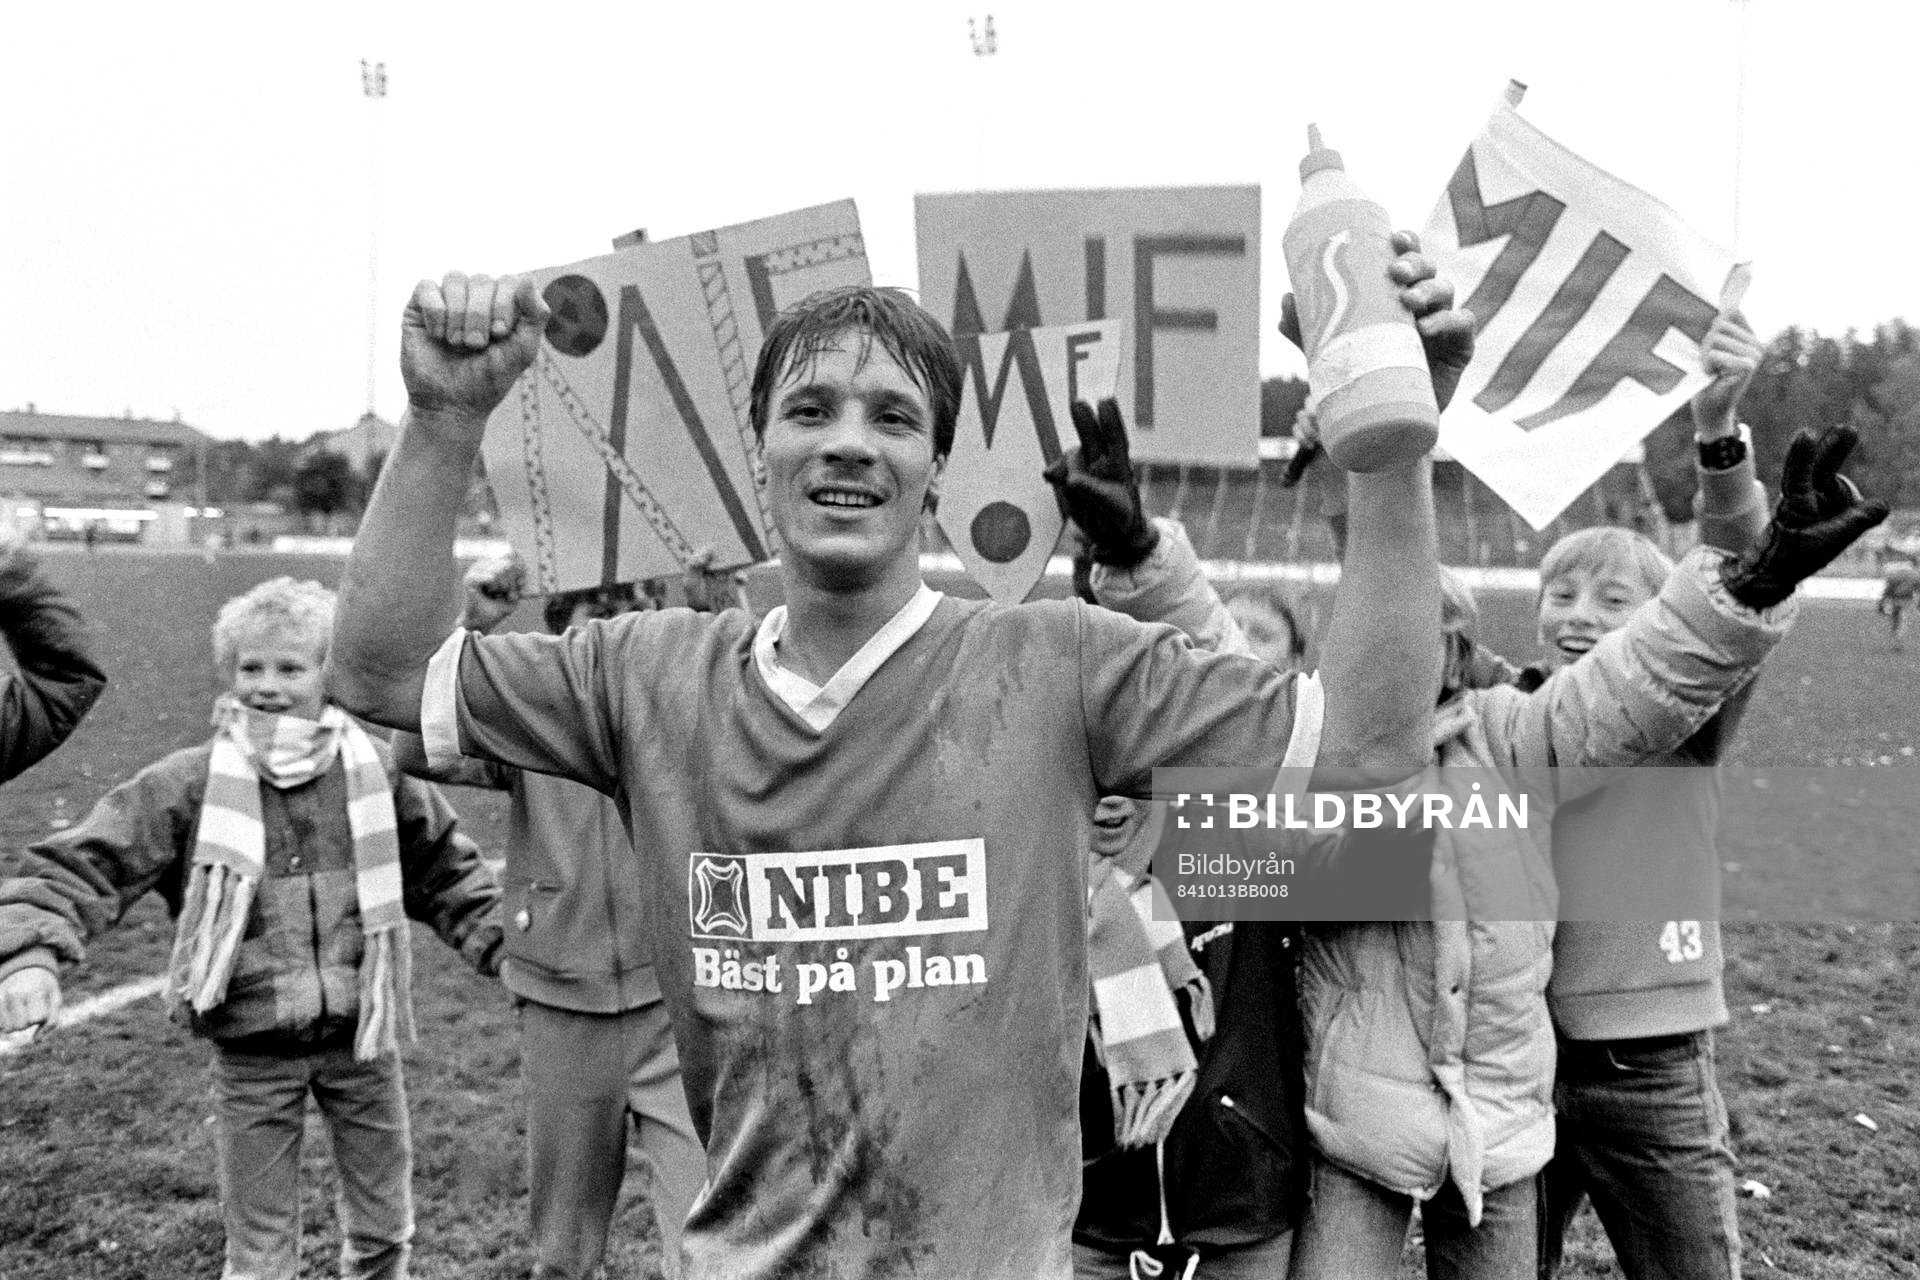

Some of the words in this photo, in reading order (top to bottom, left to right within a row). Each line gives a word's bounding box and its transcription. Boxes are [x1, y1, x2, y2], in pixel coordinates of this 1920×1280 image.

[1446, 142, 1720, 433] MIF
[764, 853, 969, 930] NIBE
[692, 947, 782, 993] Bäst
[796, 947, 857, 1005] på
[872, 946, 988, 1002] plan
[1659, 920, 1703, 964] 43
